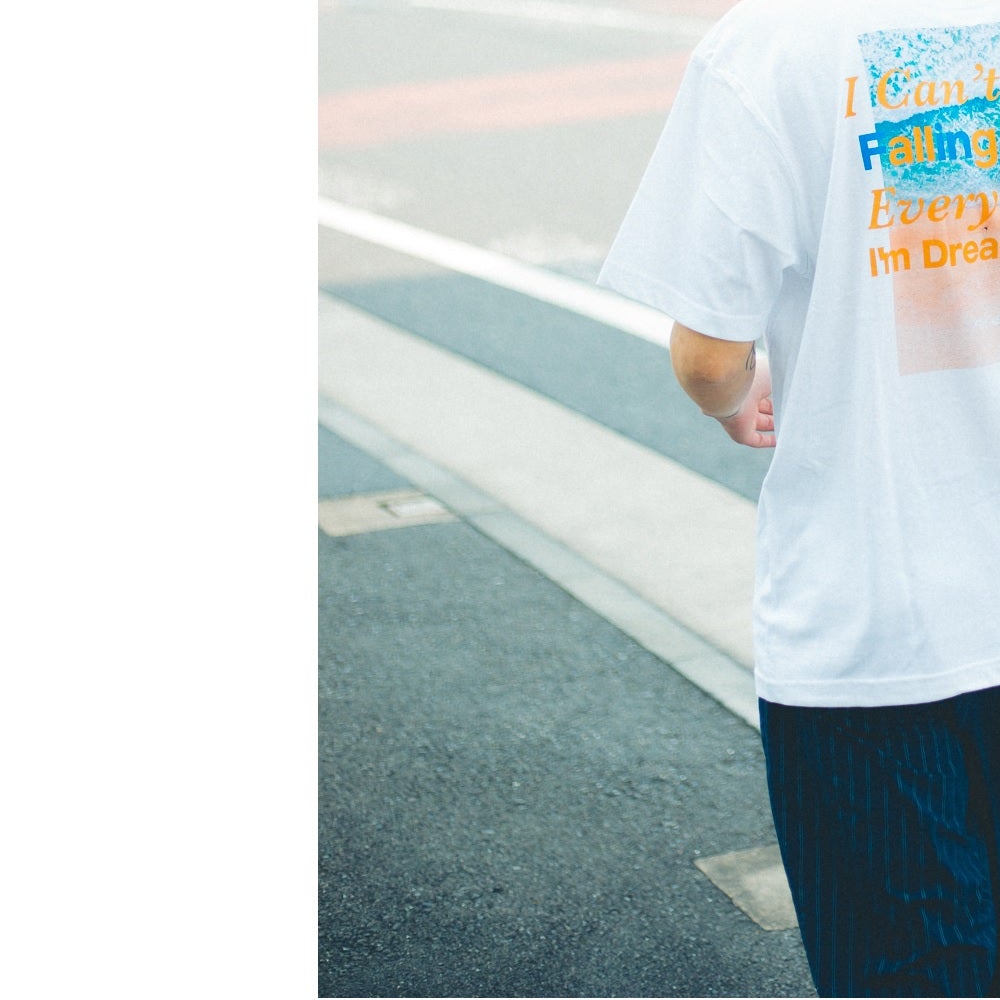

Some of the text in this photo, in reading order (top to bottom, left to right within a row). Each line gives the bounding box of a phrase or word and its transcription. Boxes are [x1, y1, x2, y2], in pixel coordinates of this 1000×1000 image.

[843, 76, 859, 117] I
[877, 63, 1000, 109] Can't
[858, 122, 997, 169] Falling
[868, 187, 998, 231] Every
[869, 246, 911, 277] I'm
